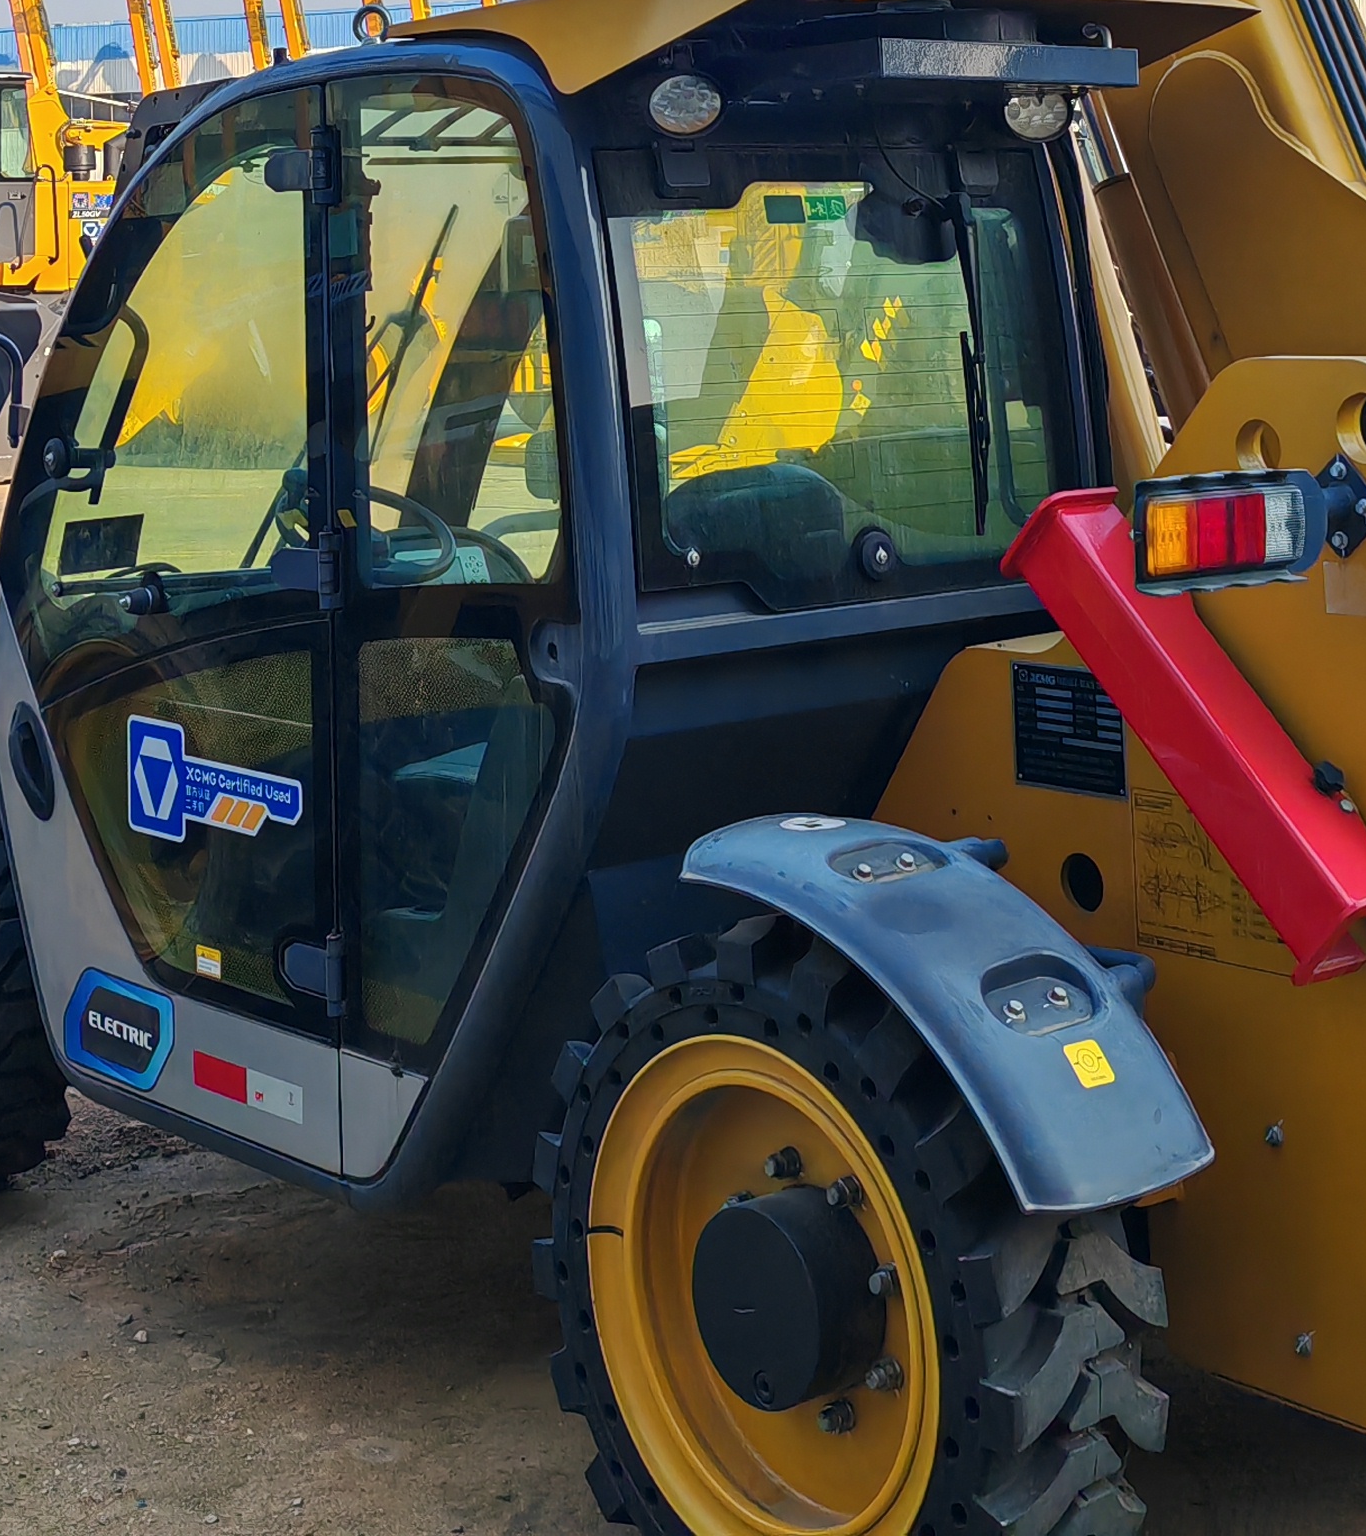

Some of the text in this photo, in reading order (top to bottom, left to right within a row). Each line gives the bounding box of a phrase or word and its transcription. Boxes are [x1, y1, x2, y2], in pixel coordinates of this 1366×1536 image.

[185, 766, 292, 805] XCMG Certified Used
[88, 1010, 153, 1052] ELECTRIC
